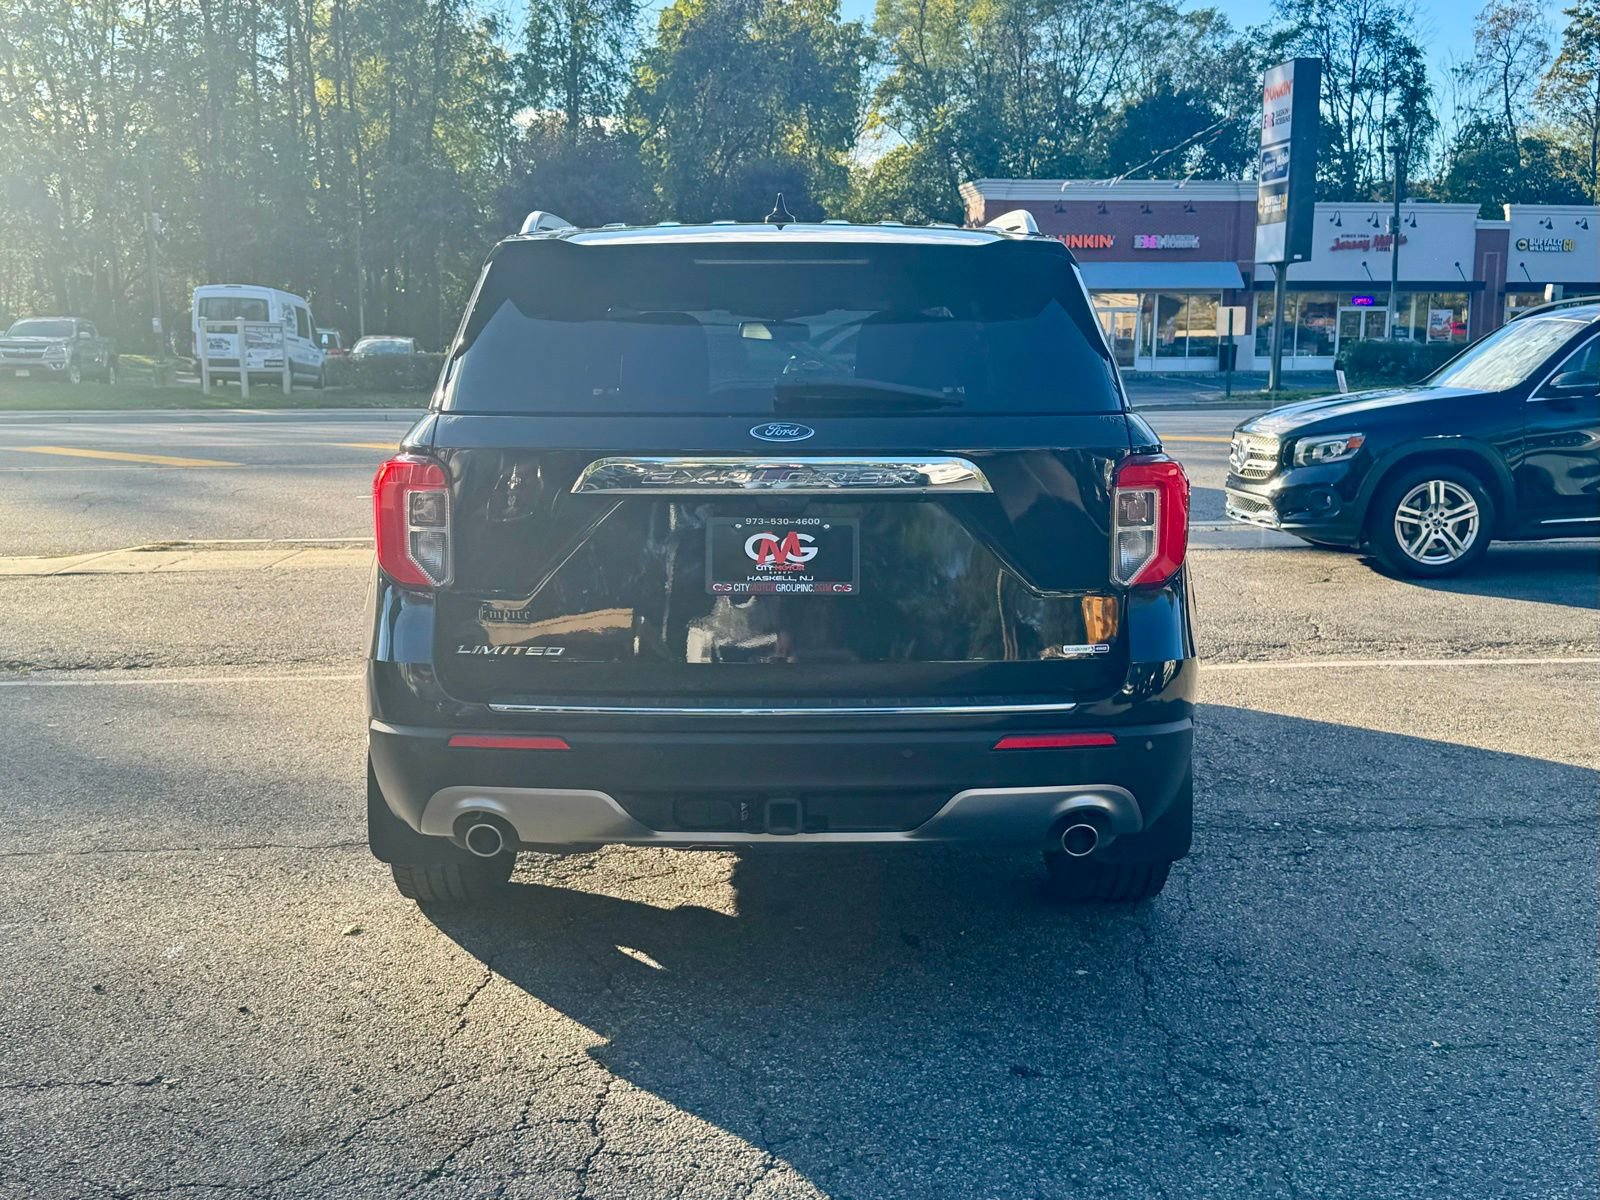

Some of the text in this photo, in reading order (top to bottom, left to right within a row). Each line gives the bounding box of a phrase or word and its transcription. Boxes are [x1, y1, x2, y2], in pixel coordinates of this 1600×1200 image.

[1058, 234, 1116, 249] UNKIN'
[1529, 238, 1563, 246] BUFFALO
[765, 423, 800, 436] Ford
[641, 469, 919, 485] EXPLORER
[745, 518, 821, 526] 973-530-4600
[456, 645, 565, 656] LIMITED
